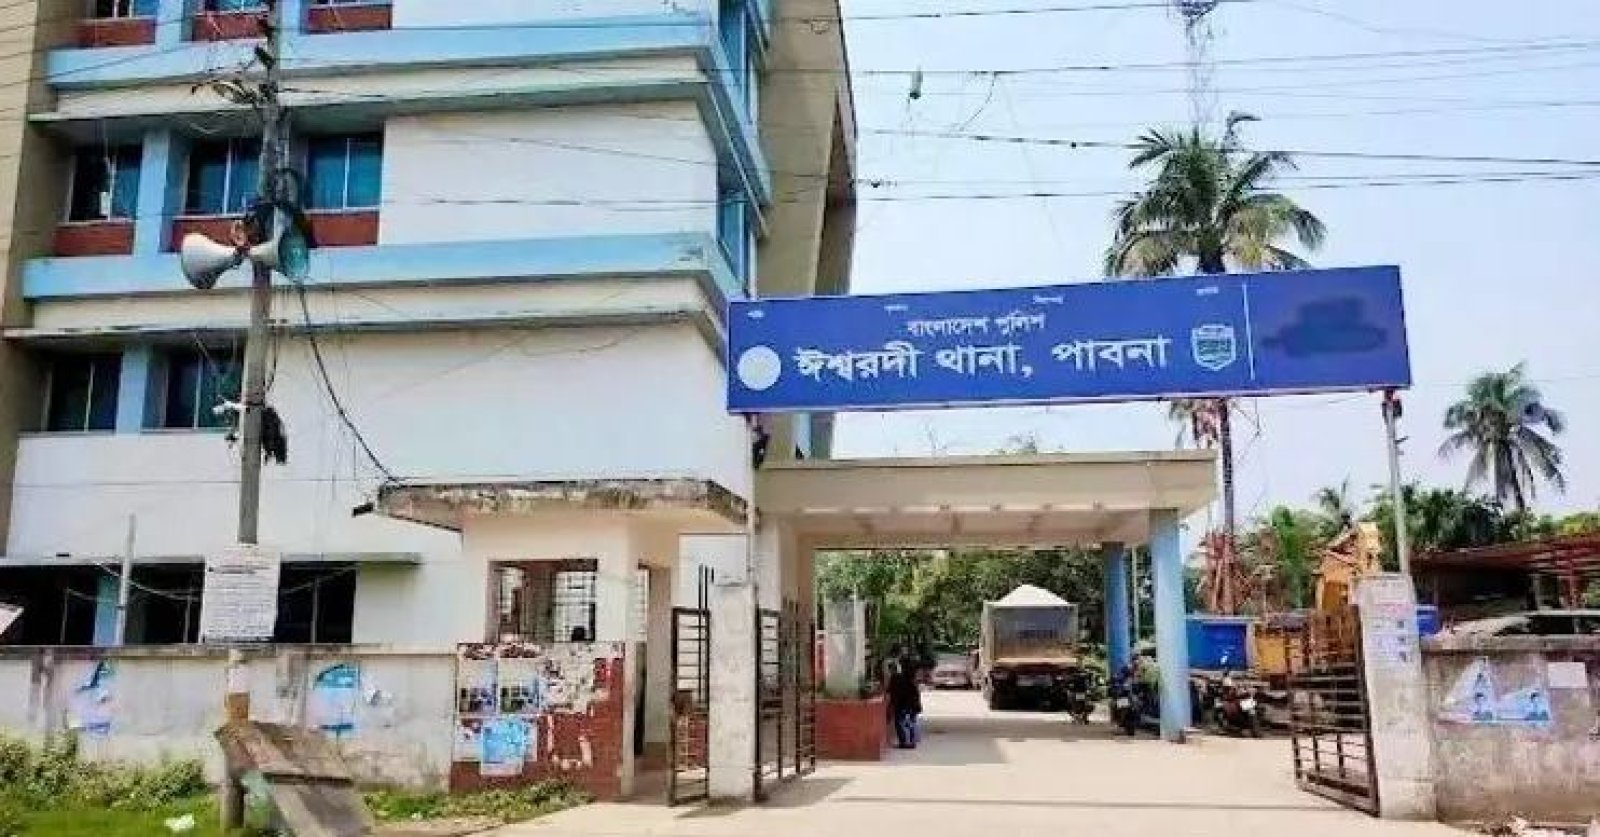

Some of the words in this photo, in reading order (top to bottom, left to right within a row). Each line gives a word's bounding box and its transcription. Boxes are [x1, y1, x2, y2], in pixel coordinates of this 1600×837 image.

[907, 316, 990, 337] বাংলাদেশ
[994, 309, 1045, 335] পুলিশ
[793, 340, 925, 381] ঈশ্বরদী
[935, 342, 1033, 378] থানা,
[1052, 333, 1172, 373] পাবনা
